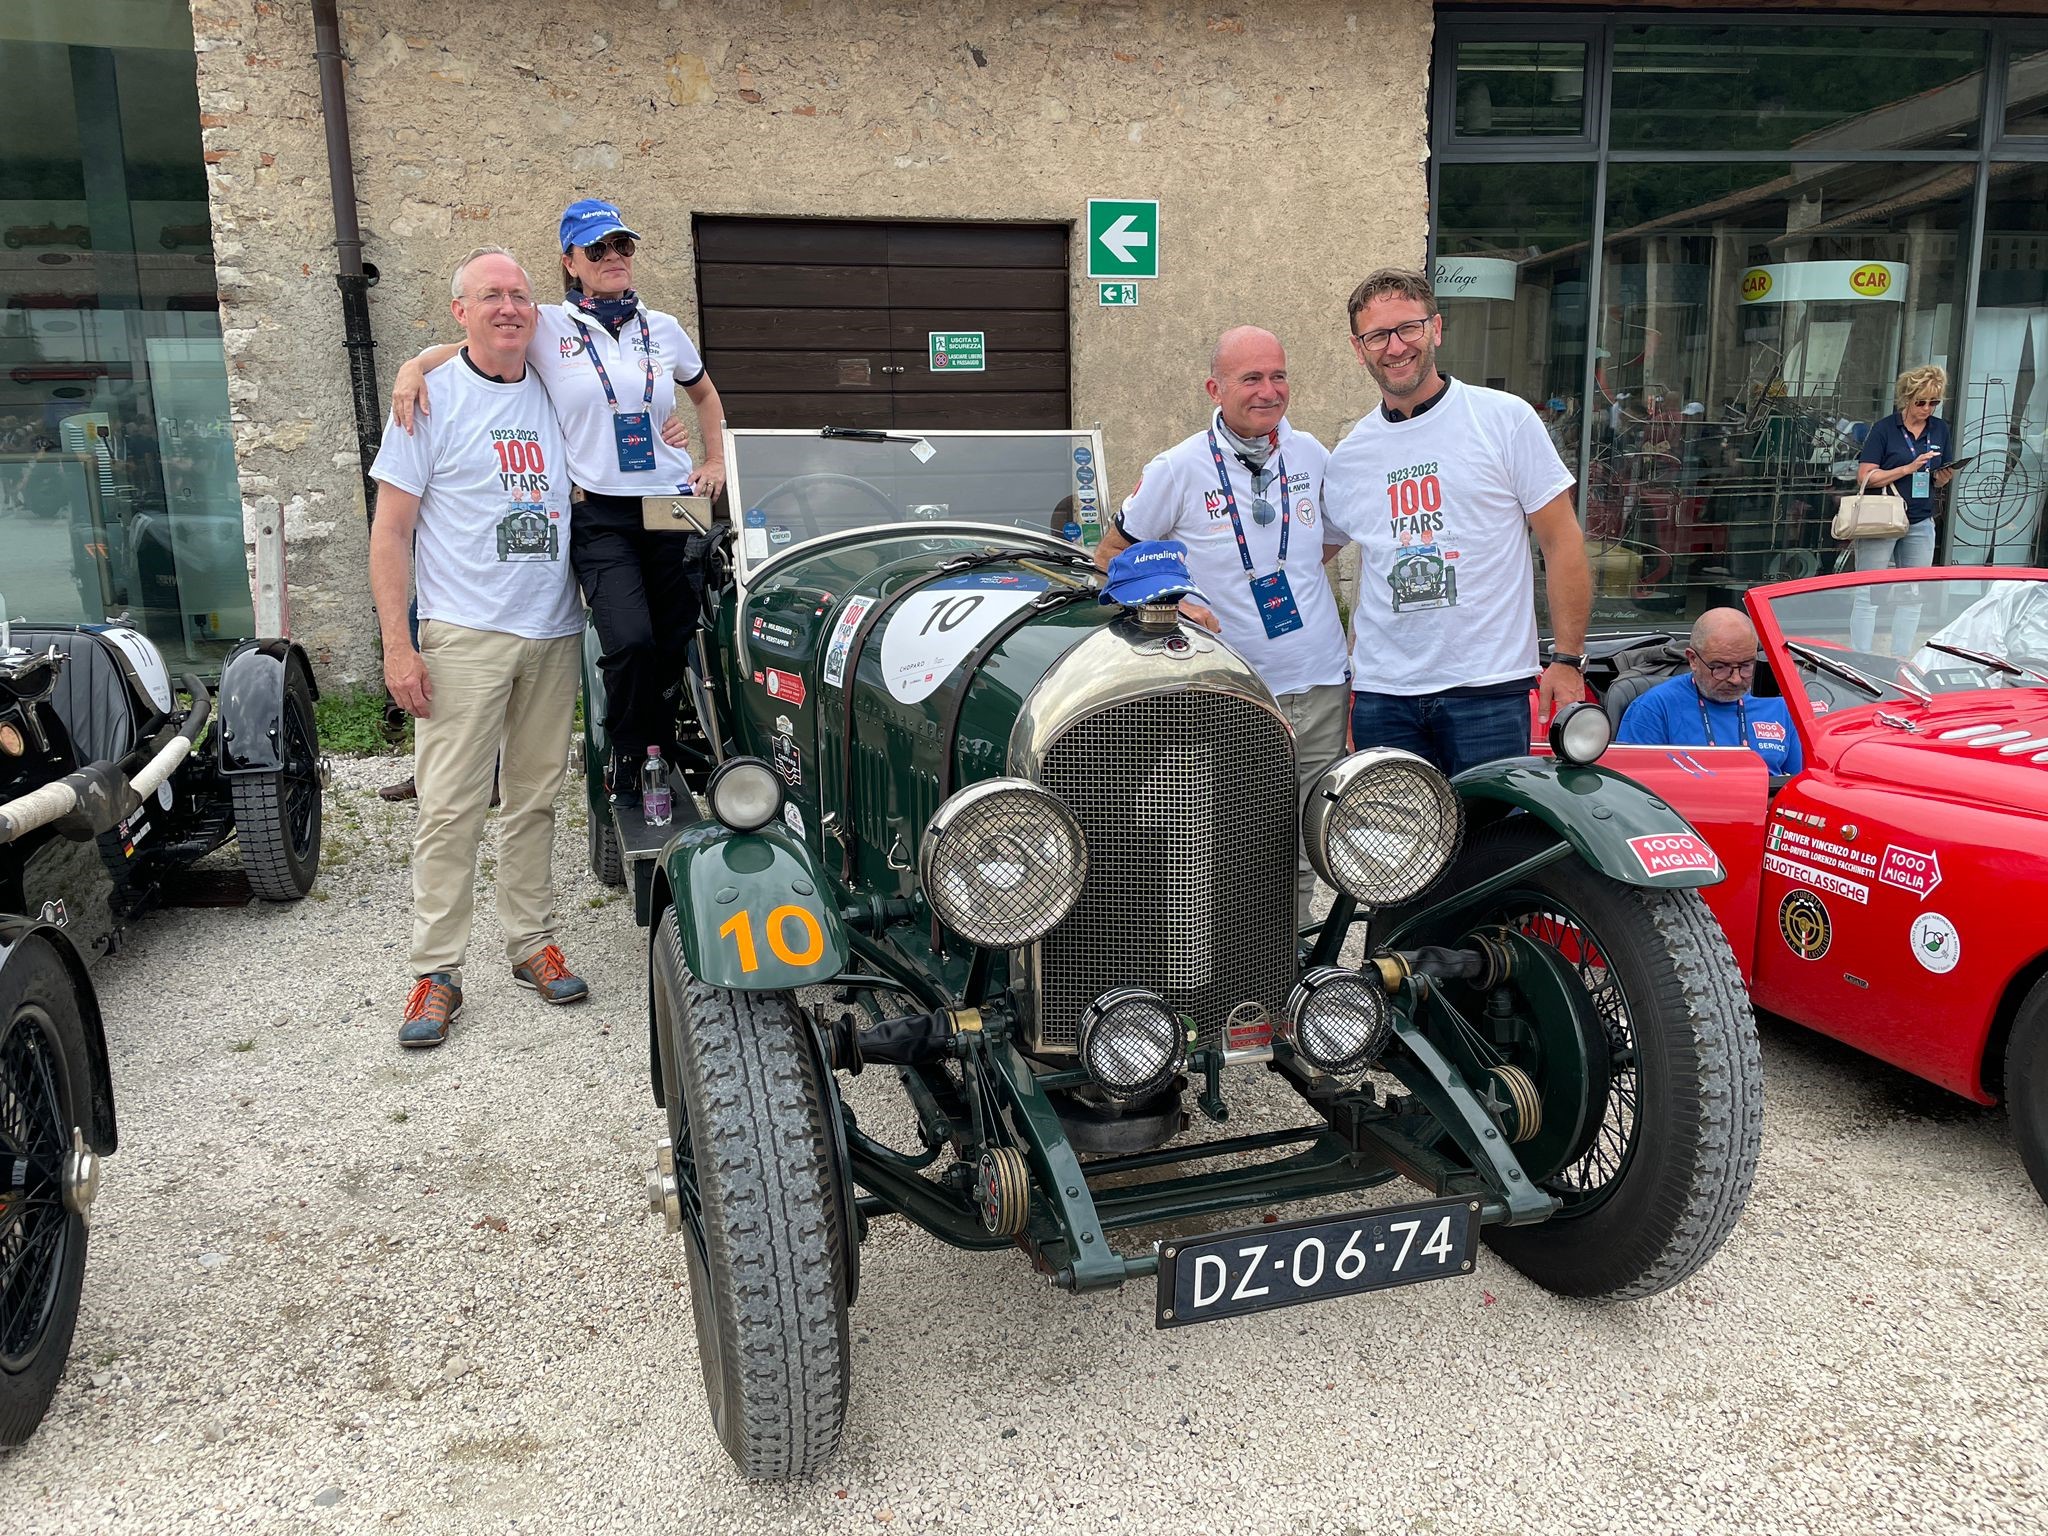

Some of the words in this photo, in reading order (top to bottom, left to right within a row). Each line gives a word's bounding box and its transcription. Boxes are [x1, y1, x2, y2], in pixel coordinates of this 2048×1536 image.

[1435, 265, 1478, 293] Perlage
[1742, 276, 1767, 294] CAR
[1853, 271, 1887, 288] CAR
[489, 428, 539, 441] 1923-2023
[493, 440, 545, 474] 100
[499, 473, 550, 492] YEARS
[1387, 461, 1438, 485] 1923-2023
[1288, 482, 1311, 493] LAVOR
[1387, 474, 1442, 519] 100
[1390, 511, 1444, 539] YEARS
[1133, 550, 1178, 564] Adrenaline
[843, 604, 864, 625] 100
[919, 595, 985, 636] 10
[899, 660, 925, 673] CHOPARD
[1758, 742, 1786, 752] SERVICE
[1643, 838, 1693, 853] 1000
[1782, 830, 1810, 847] DRIVER
[1810, 838, 1849, 858] VINCENZO
[1850, 849, 1860, 861] DI
[1860, 853, 1877, 866] LEO
[1650, 853, 1709, 870] MIGLIA
[1780, 842, 1810, 861] CO-DRIVER
[1810, 852, 1837, 867] LORENZO
[1837, 860, 1876, 879] FACCHINETTI
[1891, 853, 1926, 872] 1000
[1884, 867, 1924, 889] MIGLIA
[1792, 891, 1821, 910] SCUDERIA
[719, 904, 825, 974] 10
